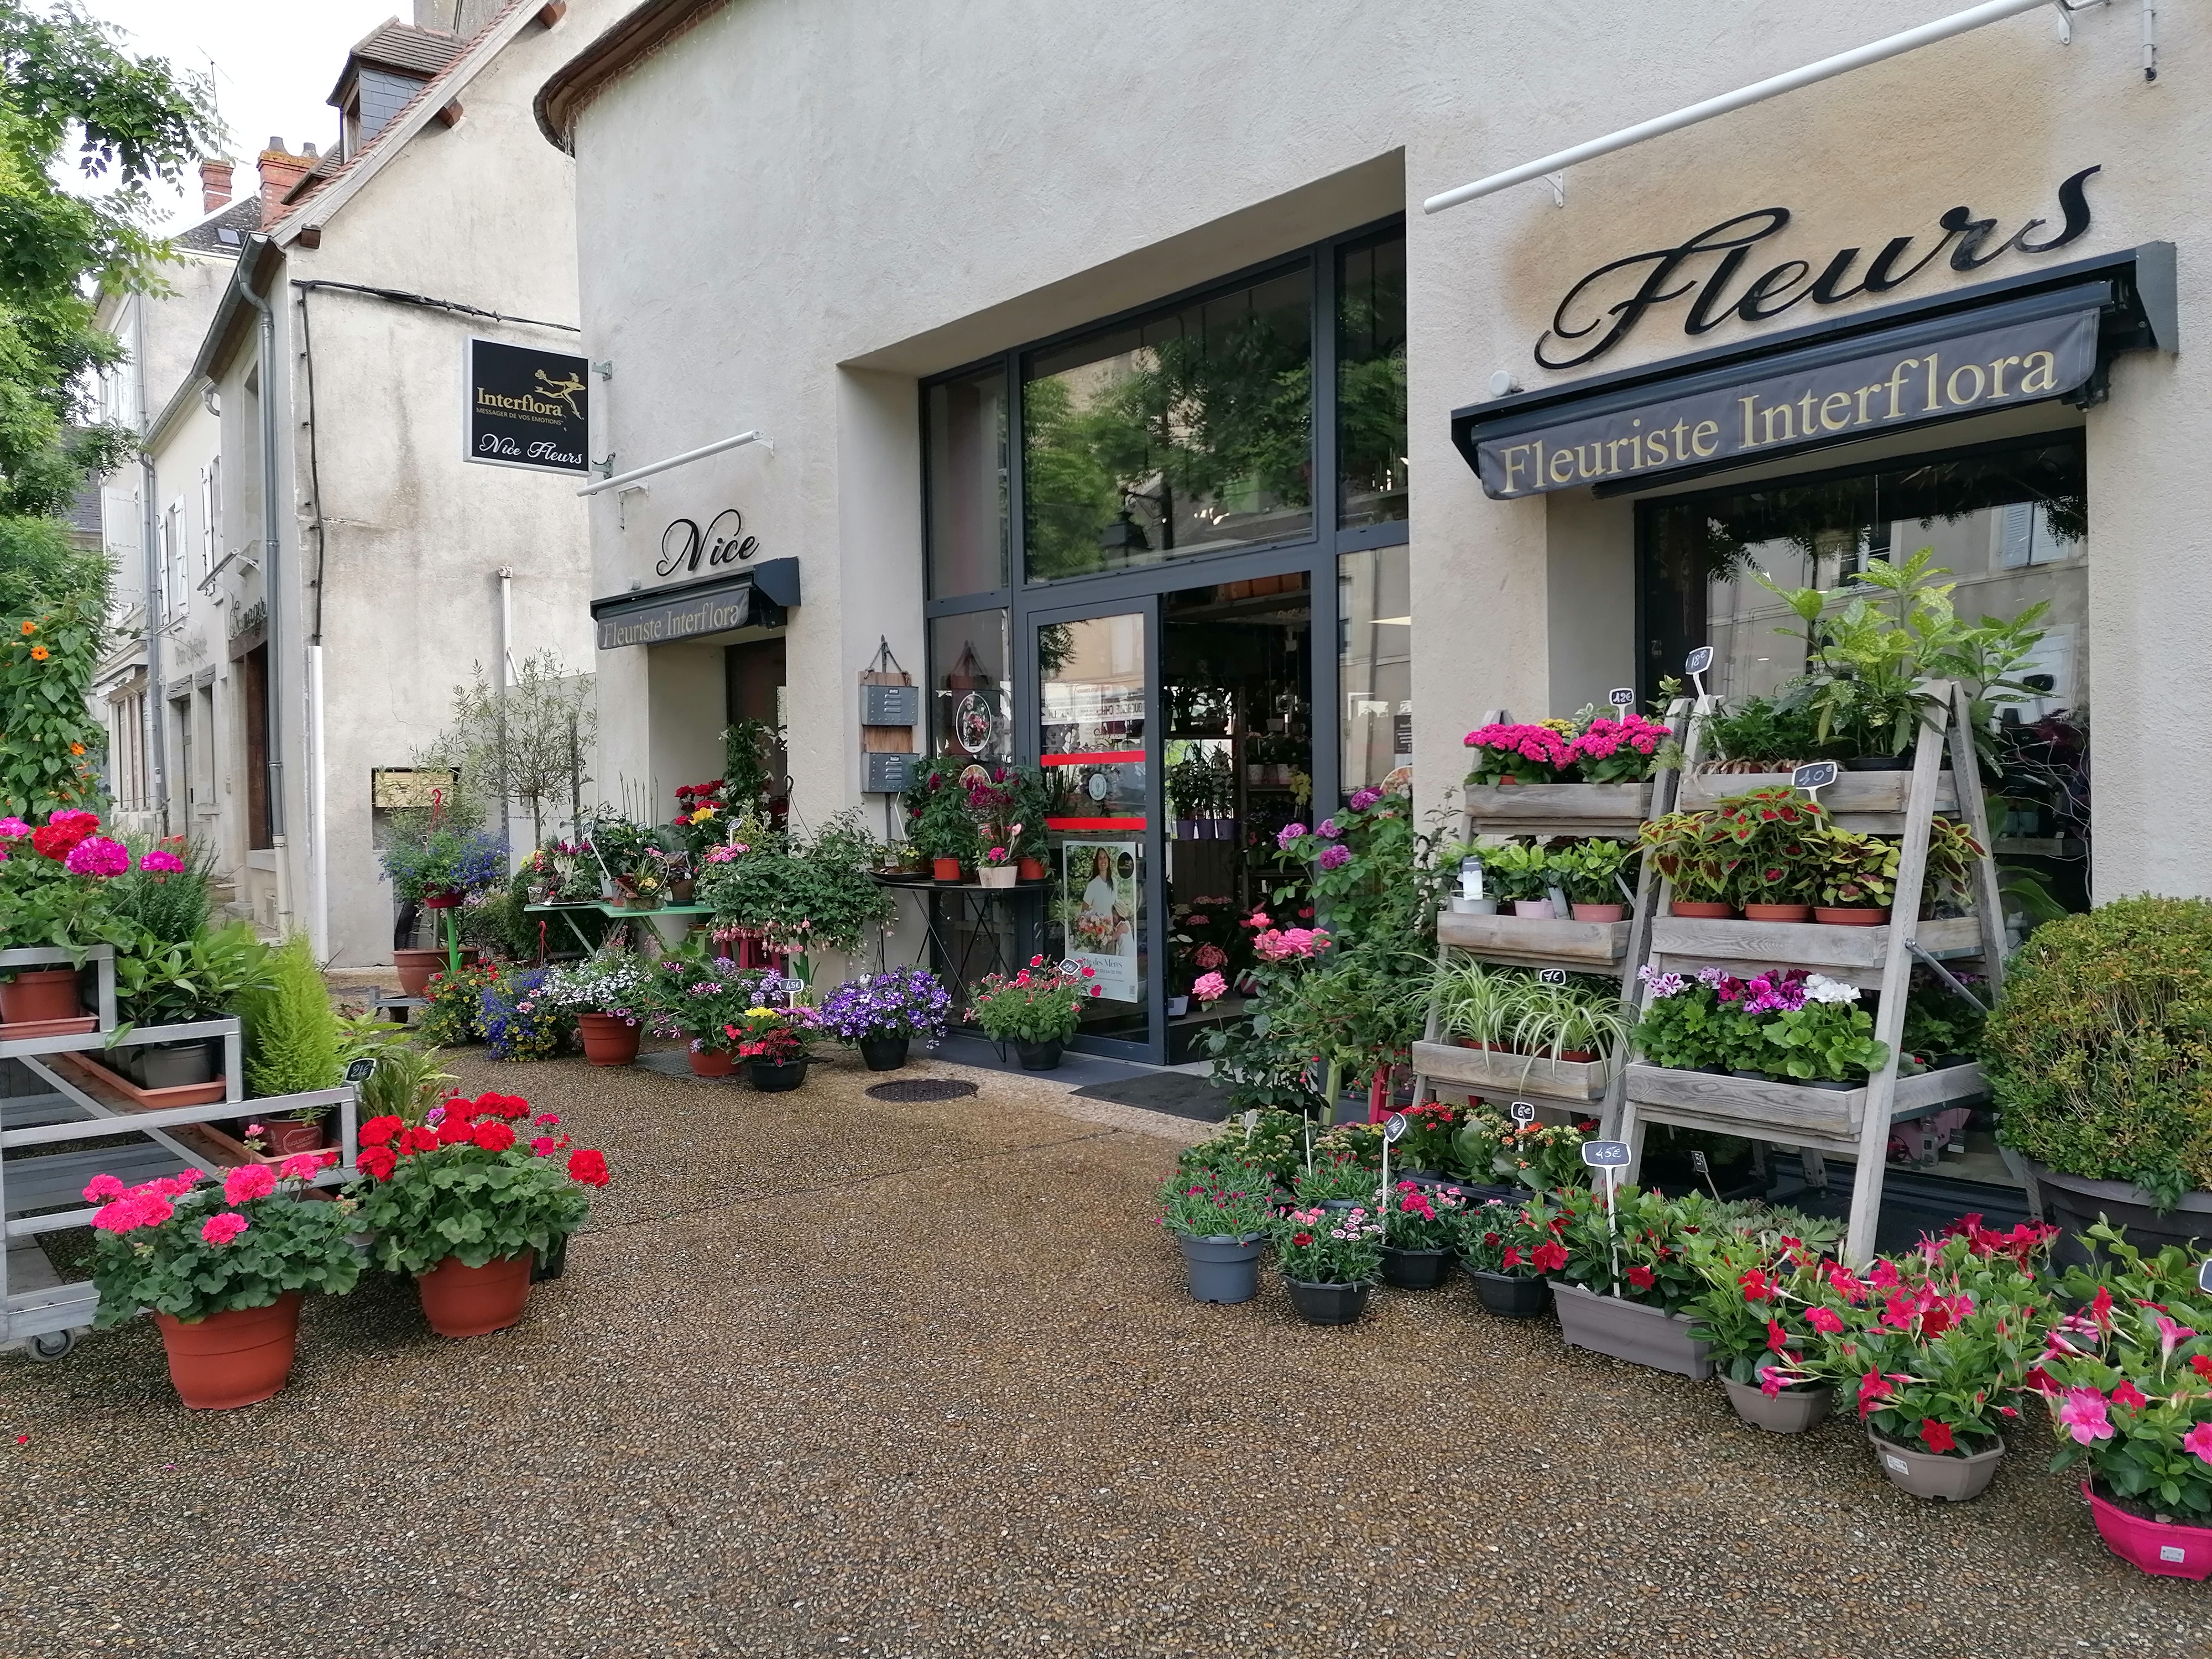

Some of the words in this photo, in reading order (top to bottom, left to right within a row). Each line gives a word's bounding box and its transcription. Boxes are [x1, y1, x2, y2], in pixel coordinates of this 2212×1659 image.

[1533, 163, 2102, 369] Fleurs
[476, 408, 510, 417] MESSAGER
[477, 387, 562, 416] Interflora
[1500, 415, 1719, 494] Fleuriste
[1738, 349, 2058, 449] Interflora
[479, 433, 522, 456] Nice
[527, 442, 582, 464] Fleurs
[656, 509, 759, 576] Nice
[602, 615, 661, 647] Fleuriste
[666, 602, 739, 636] Interflora
